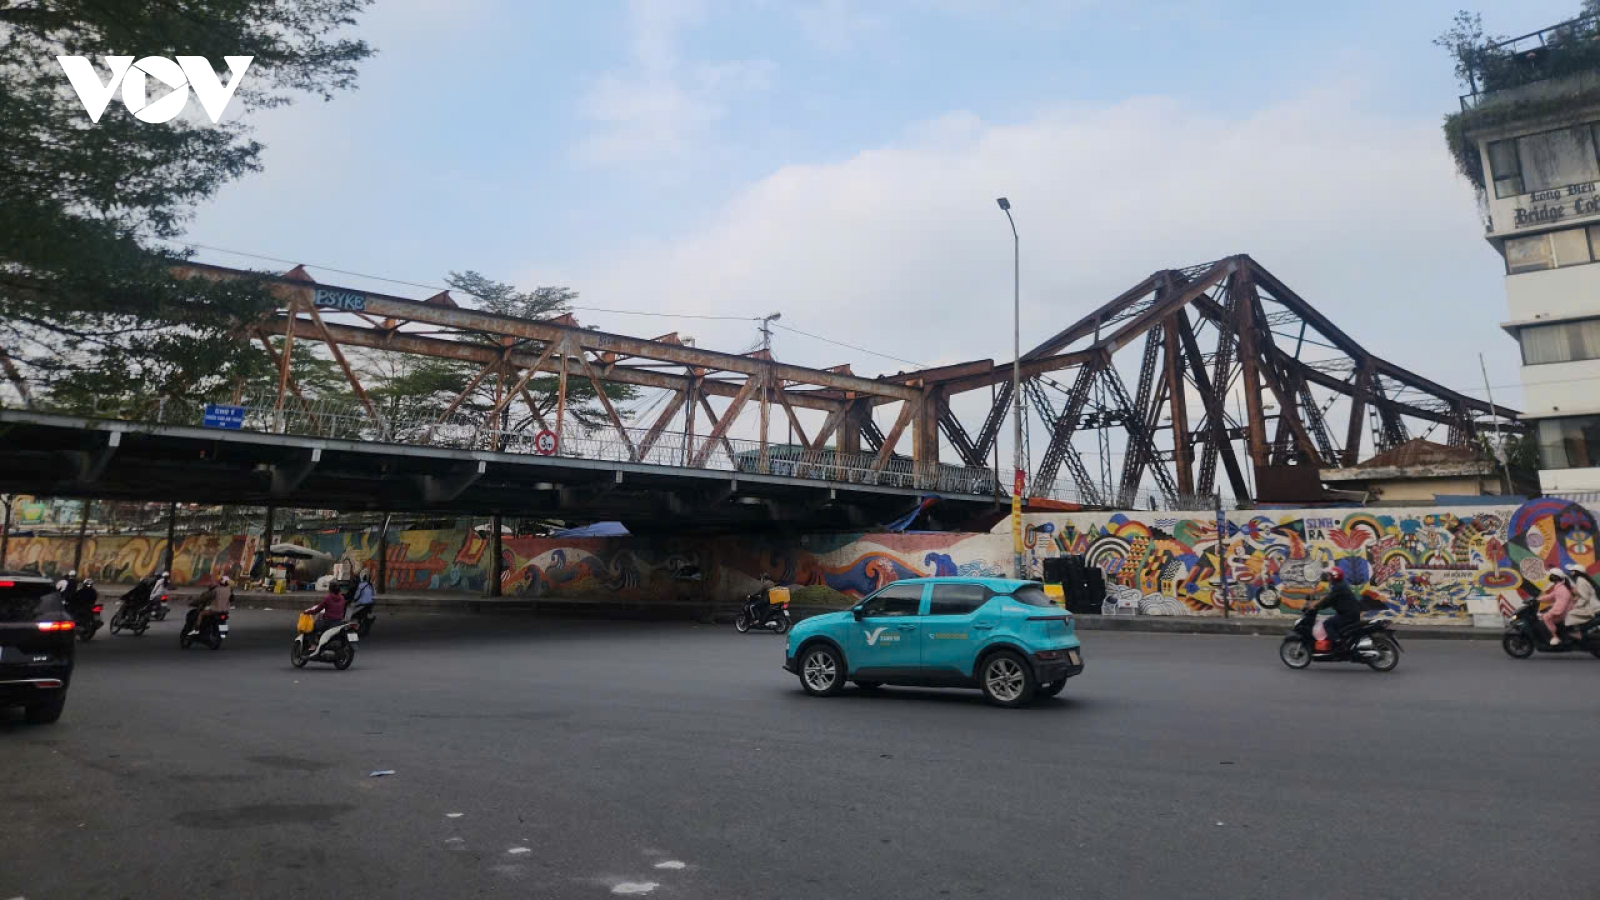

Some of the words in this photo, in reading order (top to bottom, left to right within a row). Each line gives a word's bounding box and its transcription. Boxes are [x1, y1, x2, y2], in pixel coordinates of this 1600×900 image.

[1530, 189, 1561, 203] Long
[1515, 202, 1565, 224] Bridge
[315, 290, 364, 310] PSYKE
